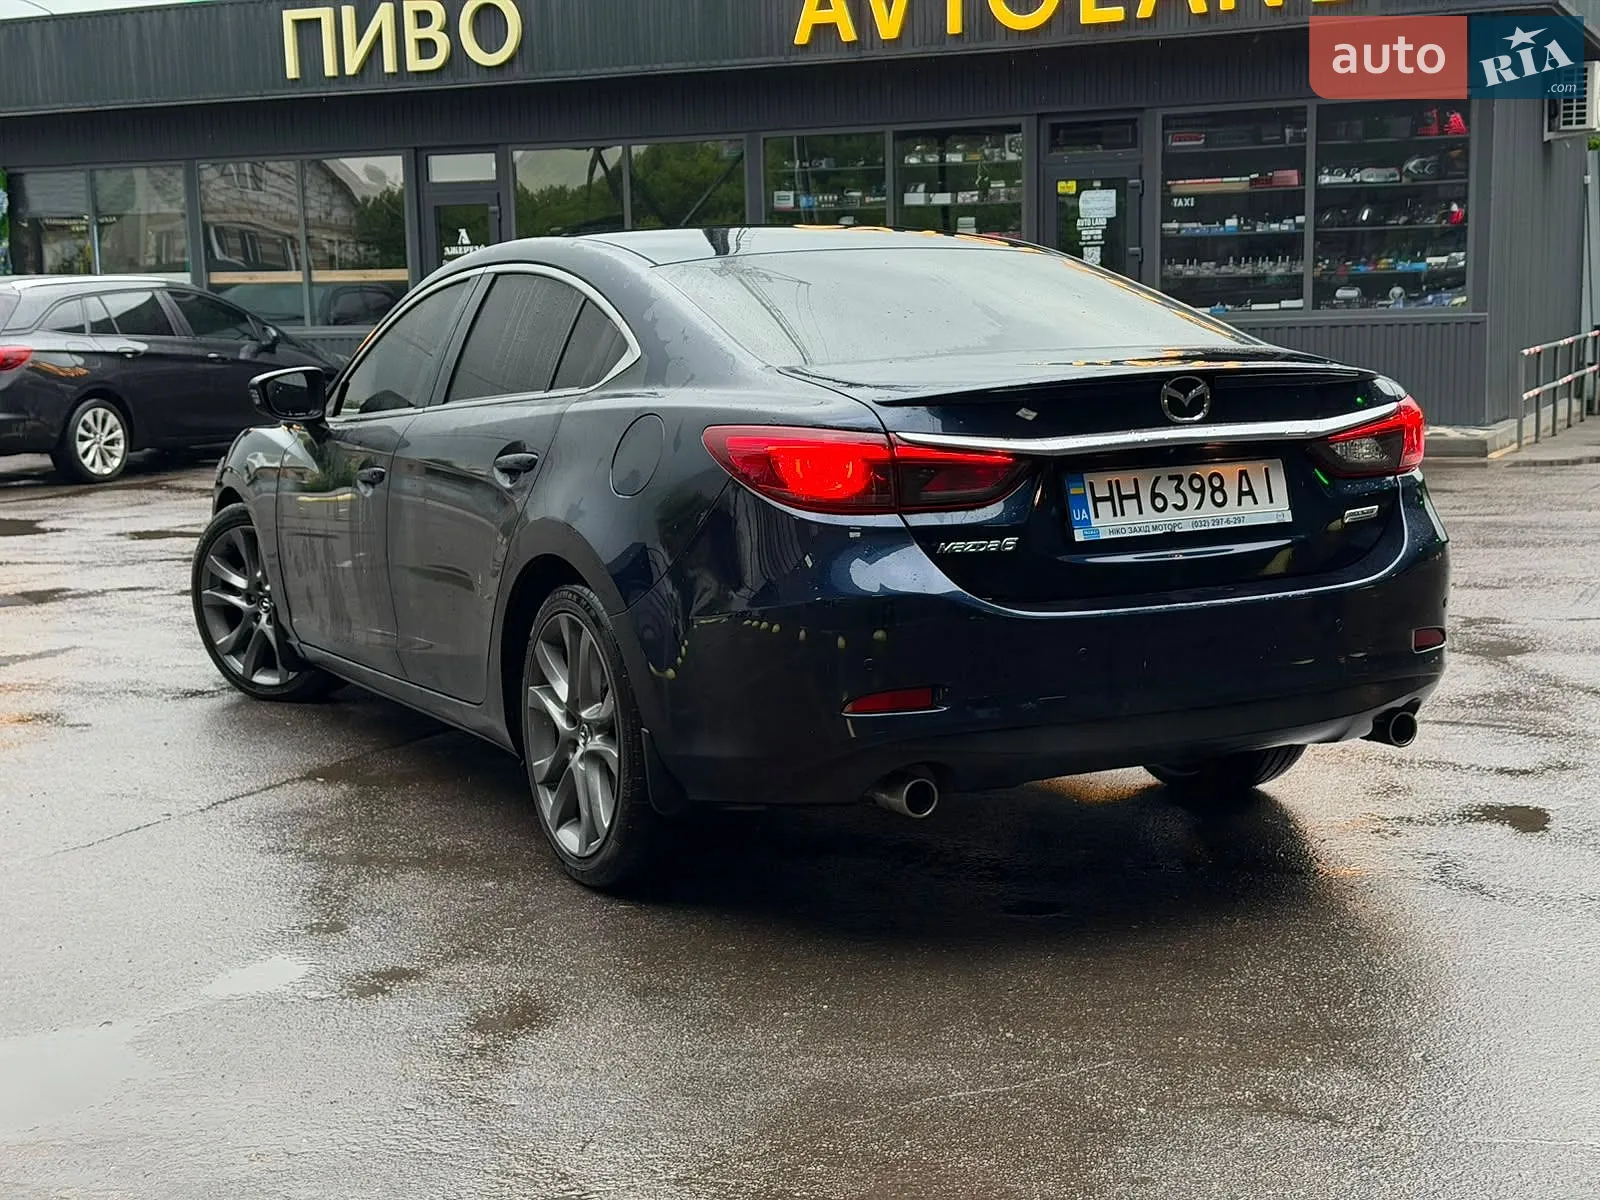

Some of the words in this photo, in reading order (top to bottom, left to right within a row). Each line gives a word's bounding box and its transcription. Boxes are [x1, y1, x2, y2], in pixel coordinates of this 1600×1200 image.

[793, 0, 1346, 45] AVTO
[282, 0, 523, 79] ПИВО
[1173, 197, 1195, 207] TAXI
[1089, 477, 1144, 519] HH
[1150, 471, 1228, 513] 6398
[1238, 466, 1275, 506] AI
[1073, 510, 1089, 521] UA
[1191, 519, 1210, 529] (032)
